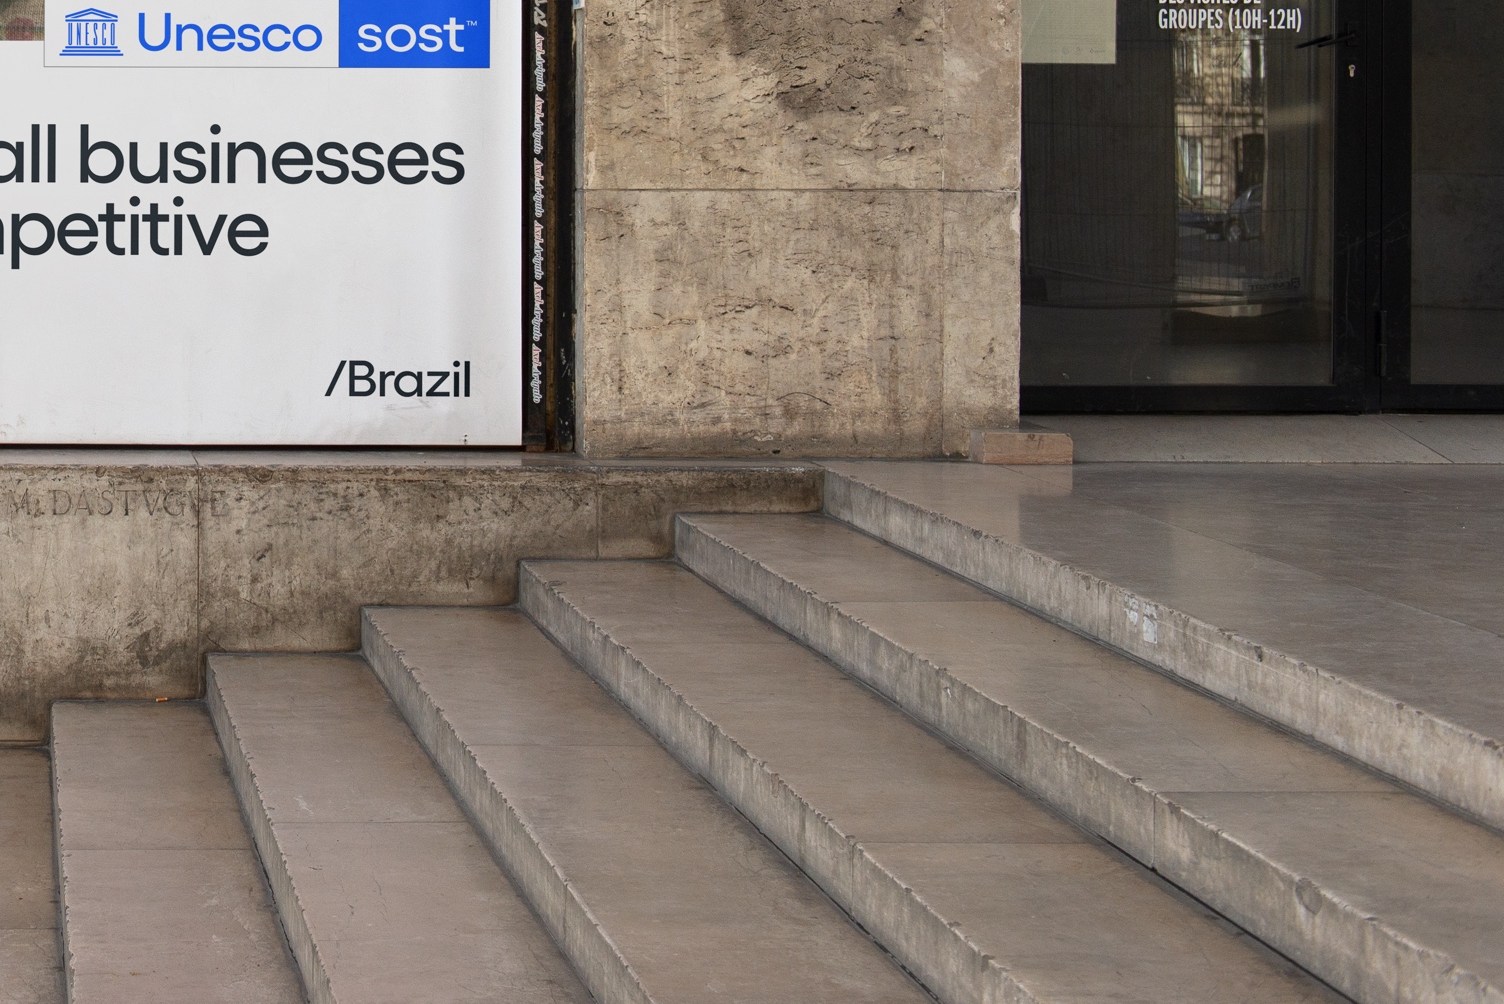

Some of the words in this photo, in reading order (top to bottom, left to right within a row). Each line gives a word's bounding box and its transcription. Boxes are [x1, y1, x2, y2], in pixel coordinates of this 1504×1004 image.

[68, 22, 116, 46] UNESCO
[138, 12, 323, 52] Unesco
[1158, 8, 1223, 30] GROUPES
[1228, 8, 1302, 32] (10H-12H)
[79, 124, 466, 185] businesses
[324, 359, 472, 398] /Brazil
